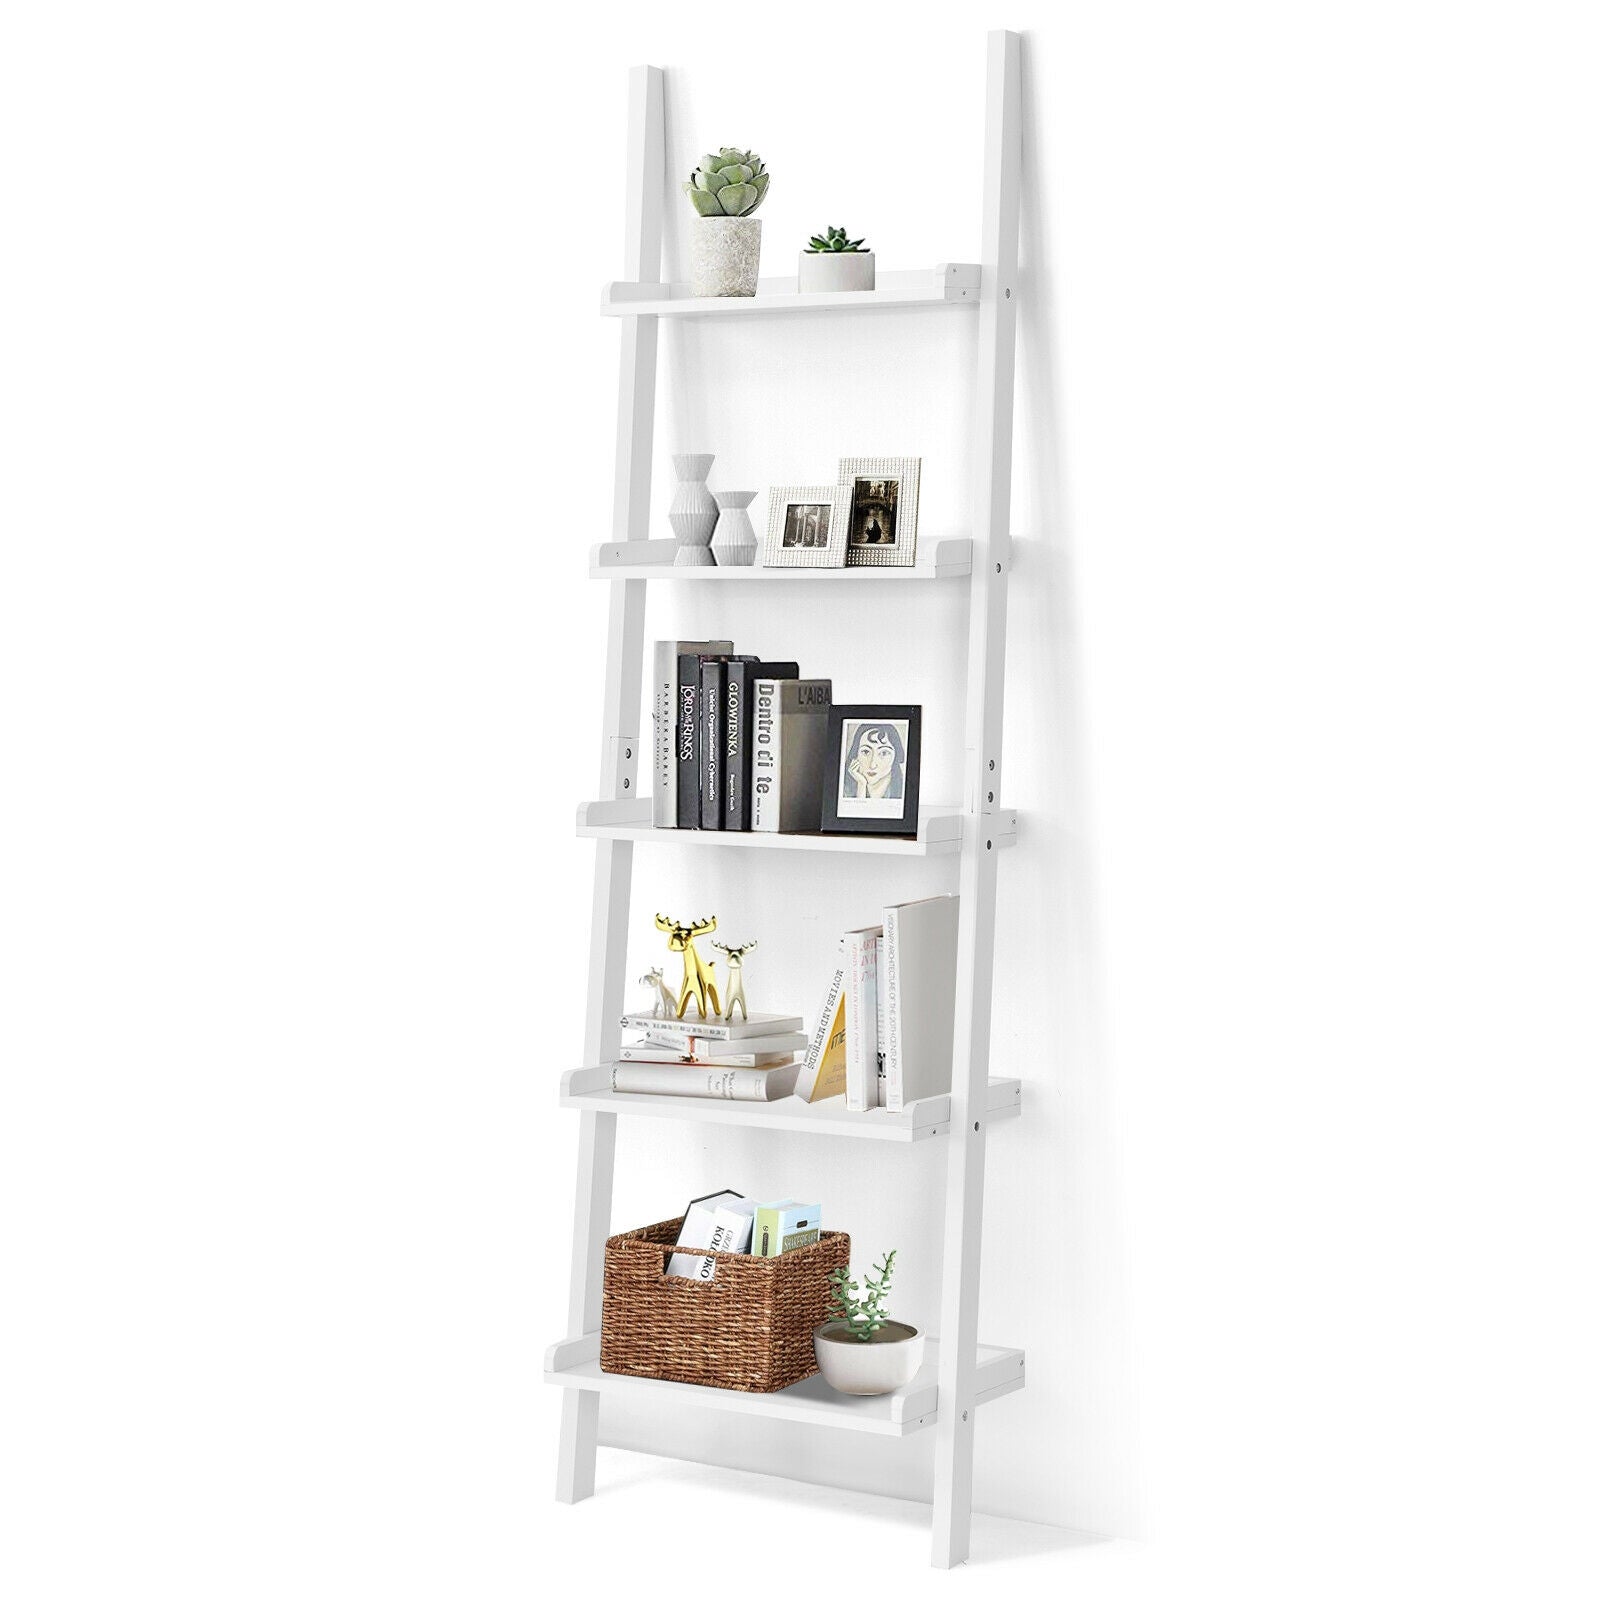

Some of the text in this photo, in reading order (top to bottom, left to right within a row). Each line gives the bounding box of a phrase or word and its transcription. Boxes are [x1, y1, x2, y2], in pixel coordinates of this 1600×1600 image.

[680, 685, 696, 715] LORD
[680, 722, 694, 761] RINGS
[756, 684, 775, 794] Dentro di te
[807, 969, 844, 1070] MOVIES AND METHODS
